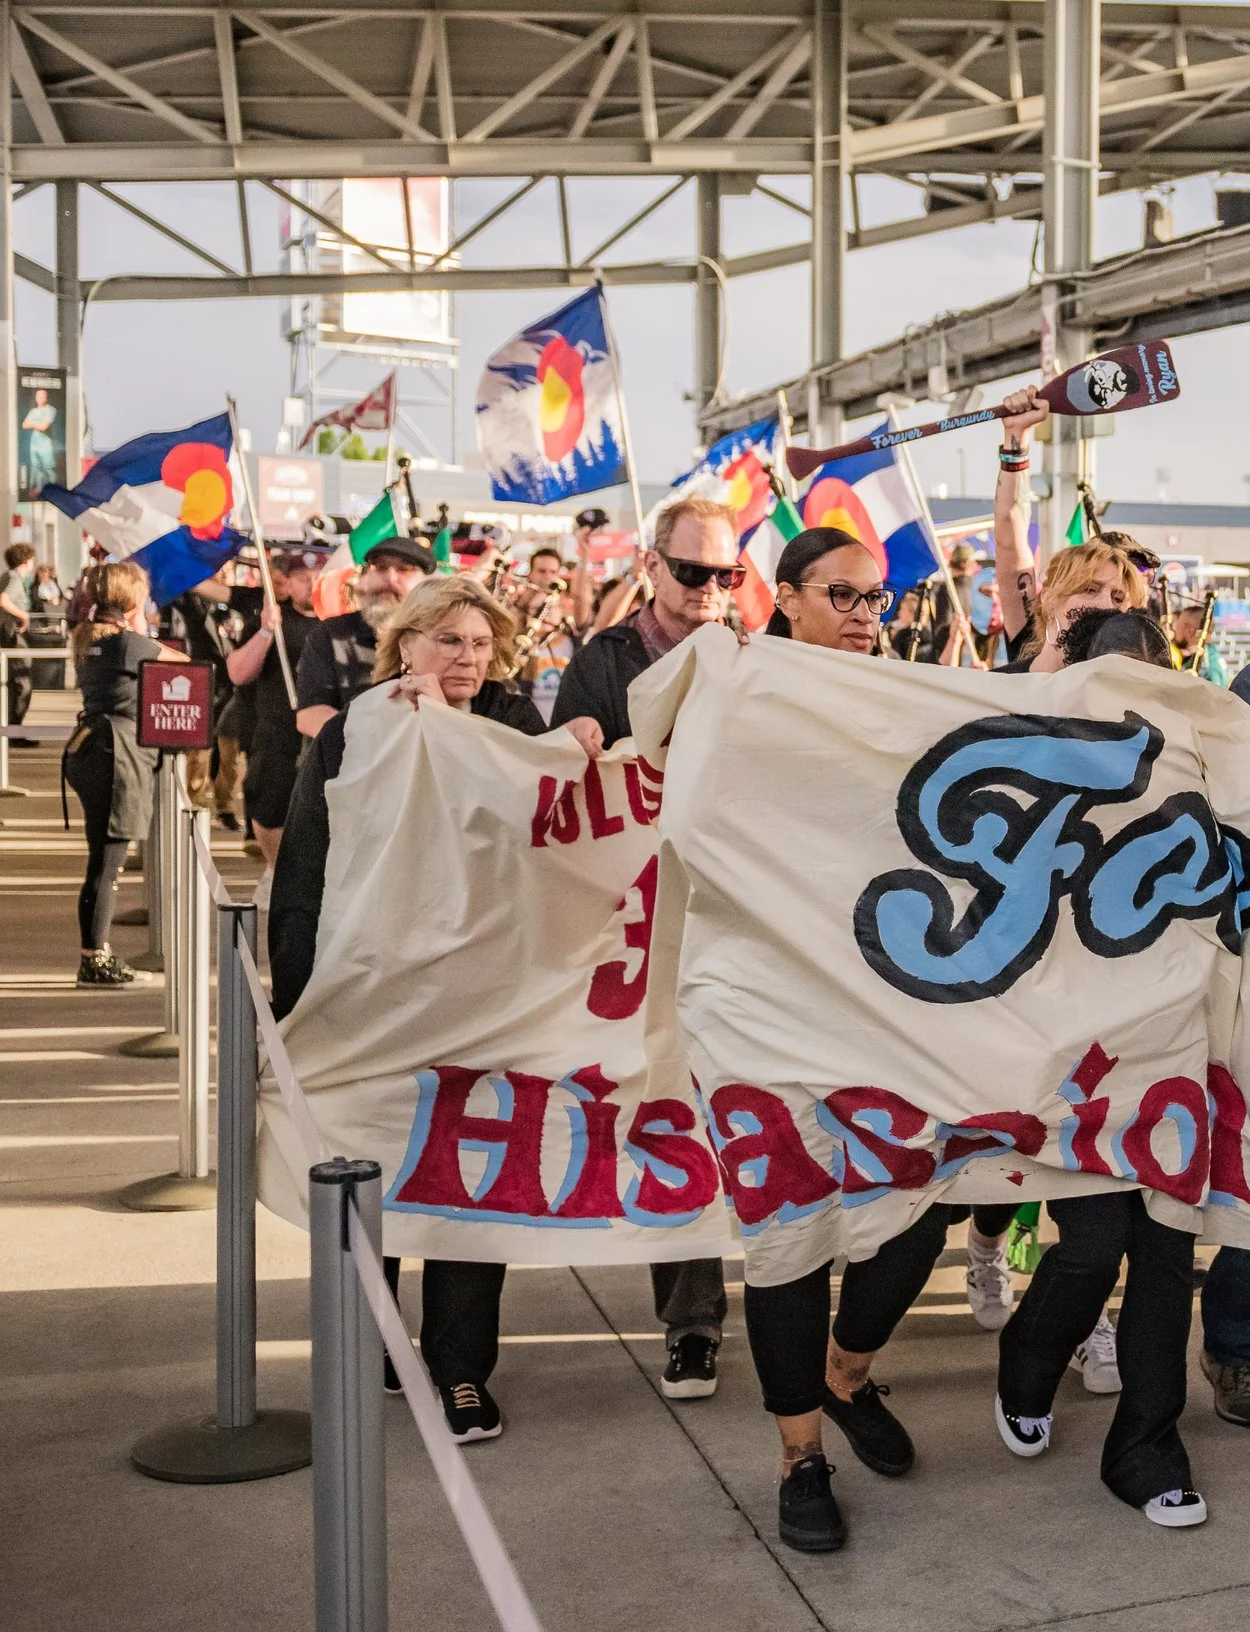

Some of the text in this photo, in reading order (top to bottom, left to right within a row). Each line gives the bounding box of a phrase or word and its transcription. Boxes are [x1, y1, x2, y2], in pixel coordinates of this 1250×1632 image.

[1156, 350, 1177, 395] Ryan
[870, 409, 995, 449] Forever Burgundy
[150, 703, 202, 719] ENTER
[154, 716, 198, 732] HERE
[381, 1063, 721, 1229] His
